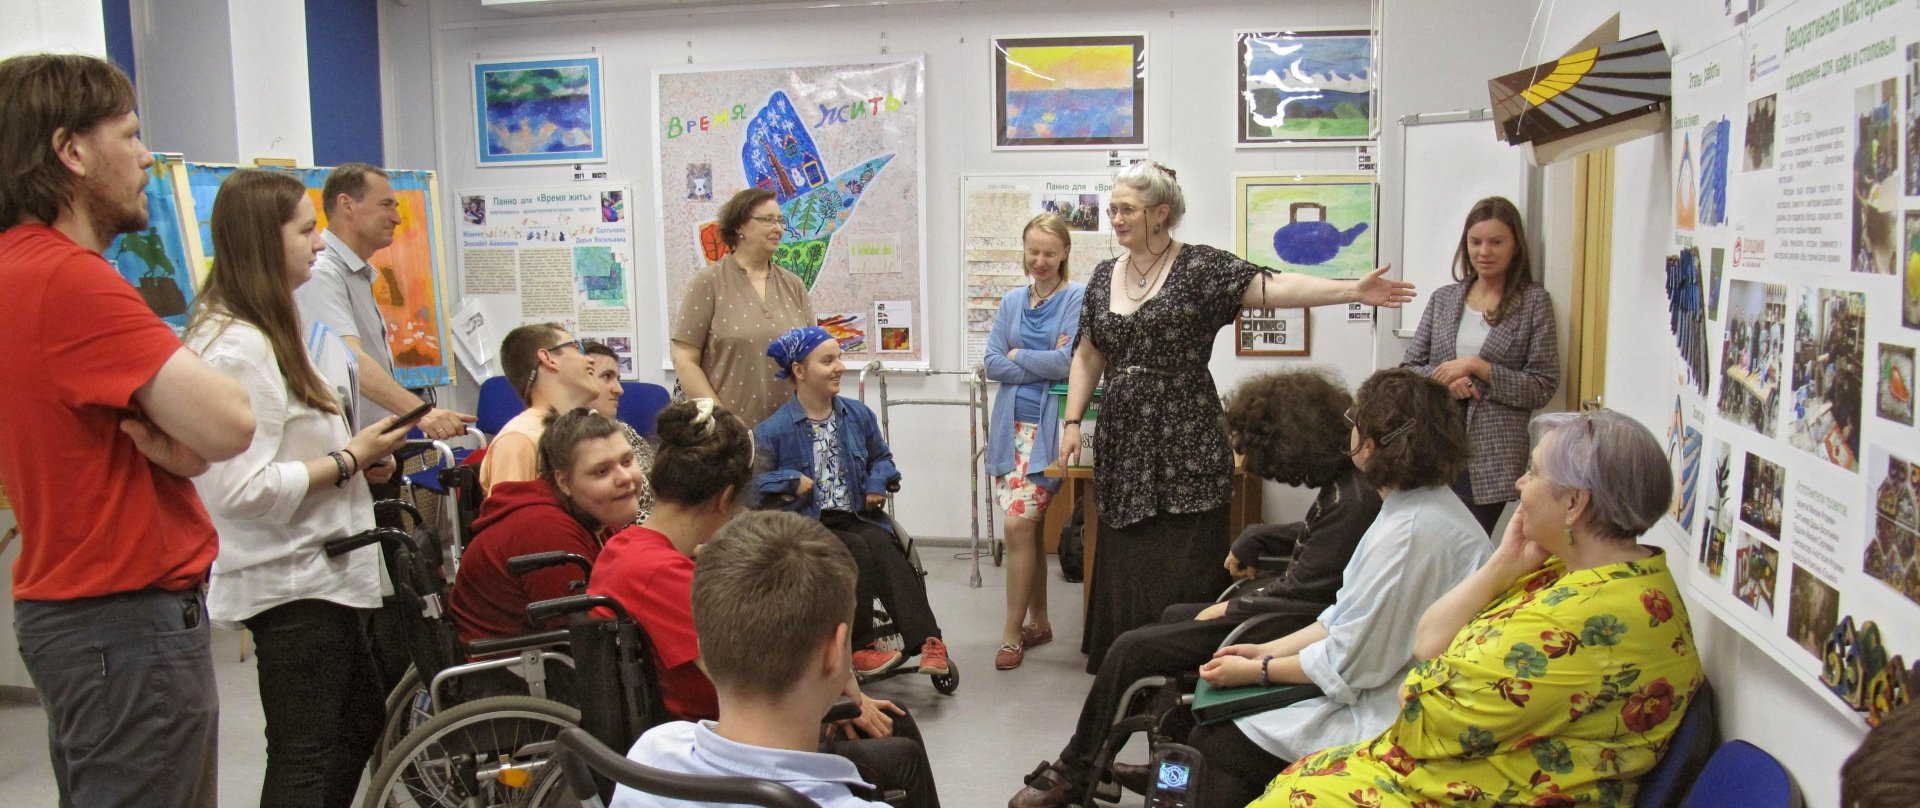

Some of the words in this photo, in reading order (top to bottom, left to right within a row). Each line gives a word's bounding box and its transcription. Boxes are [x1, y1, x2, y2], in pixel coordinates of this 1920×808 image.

[1784, 7, 1840, 58] Декоративная
[1842, 0, 1898, 27] мастерс
[1046, 182, 1069, 190] Панно
[1094, 184, 1112, 192] «Вре
[493, 197, 517, 206] Панно
[536, 193, 566, 204] «Время
[568, 194, 592, 202] жить»
[1082, 432, 1094, 448] Sv
